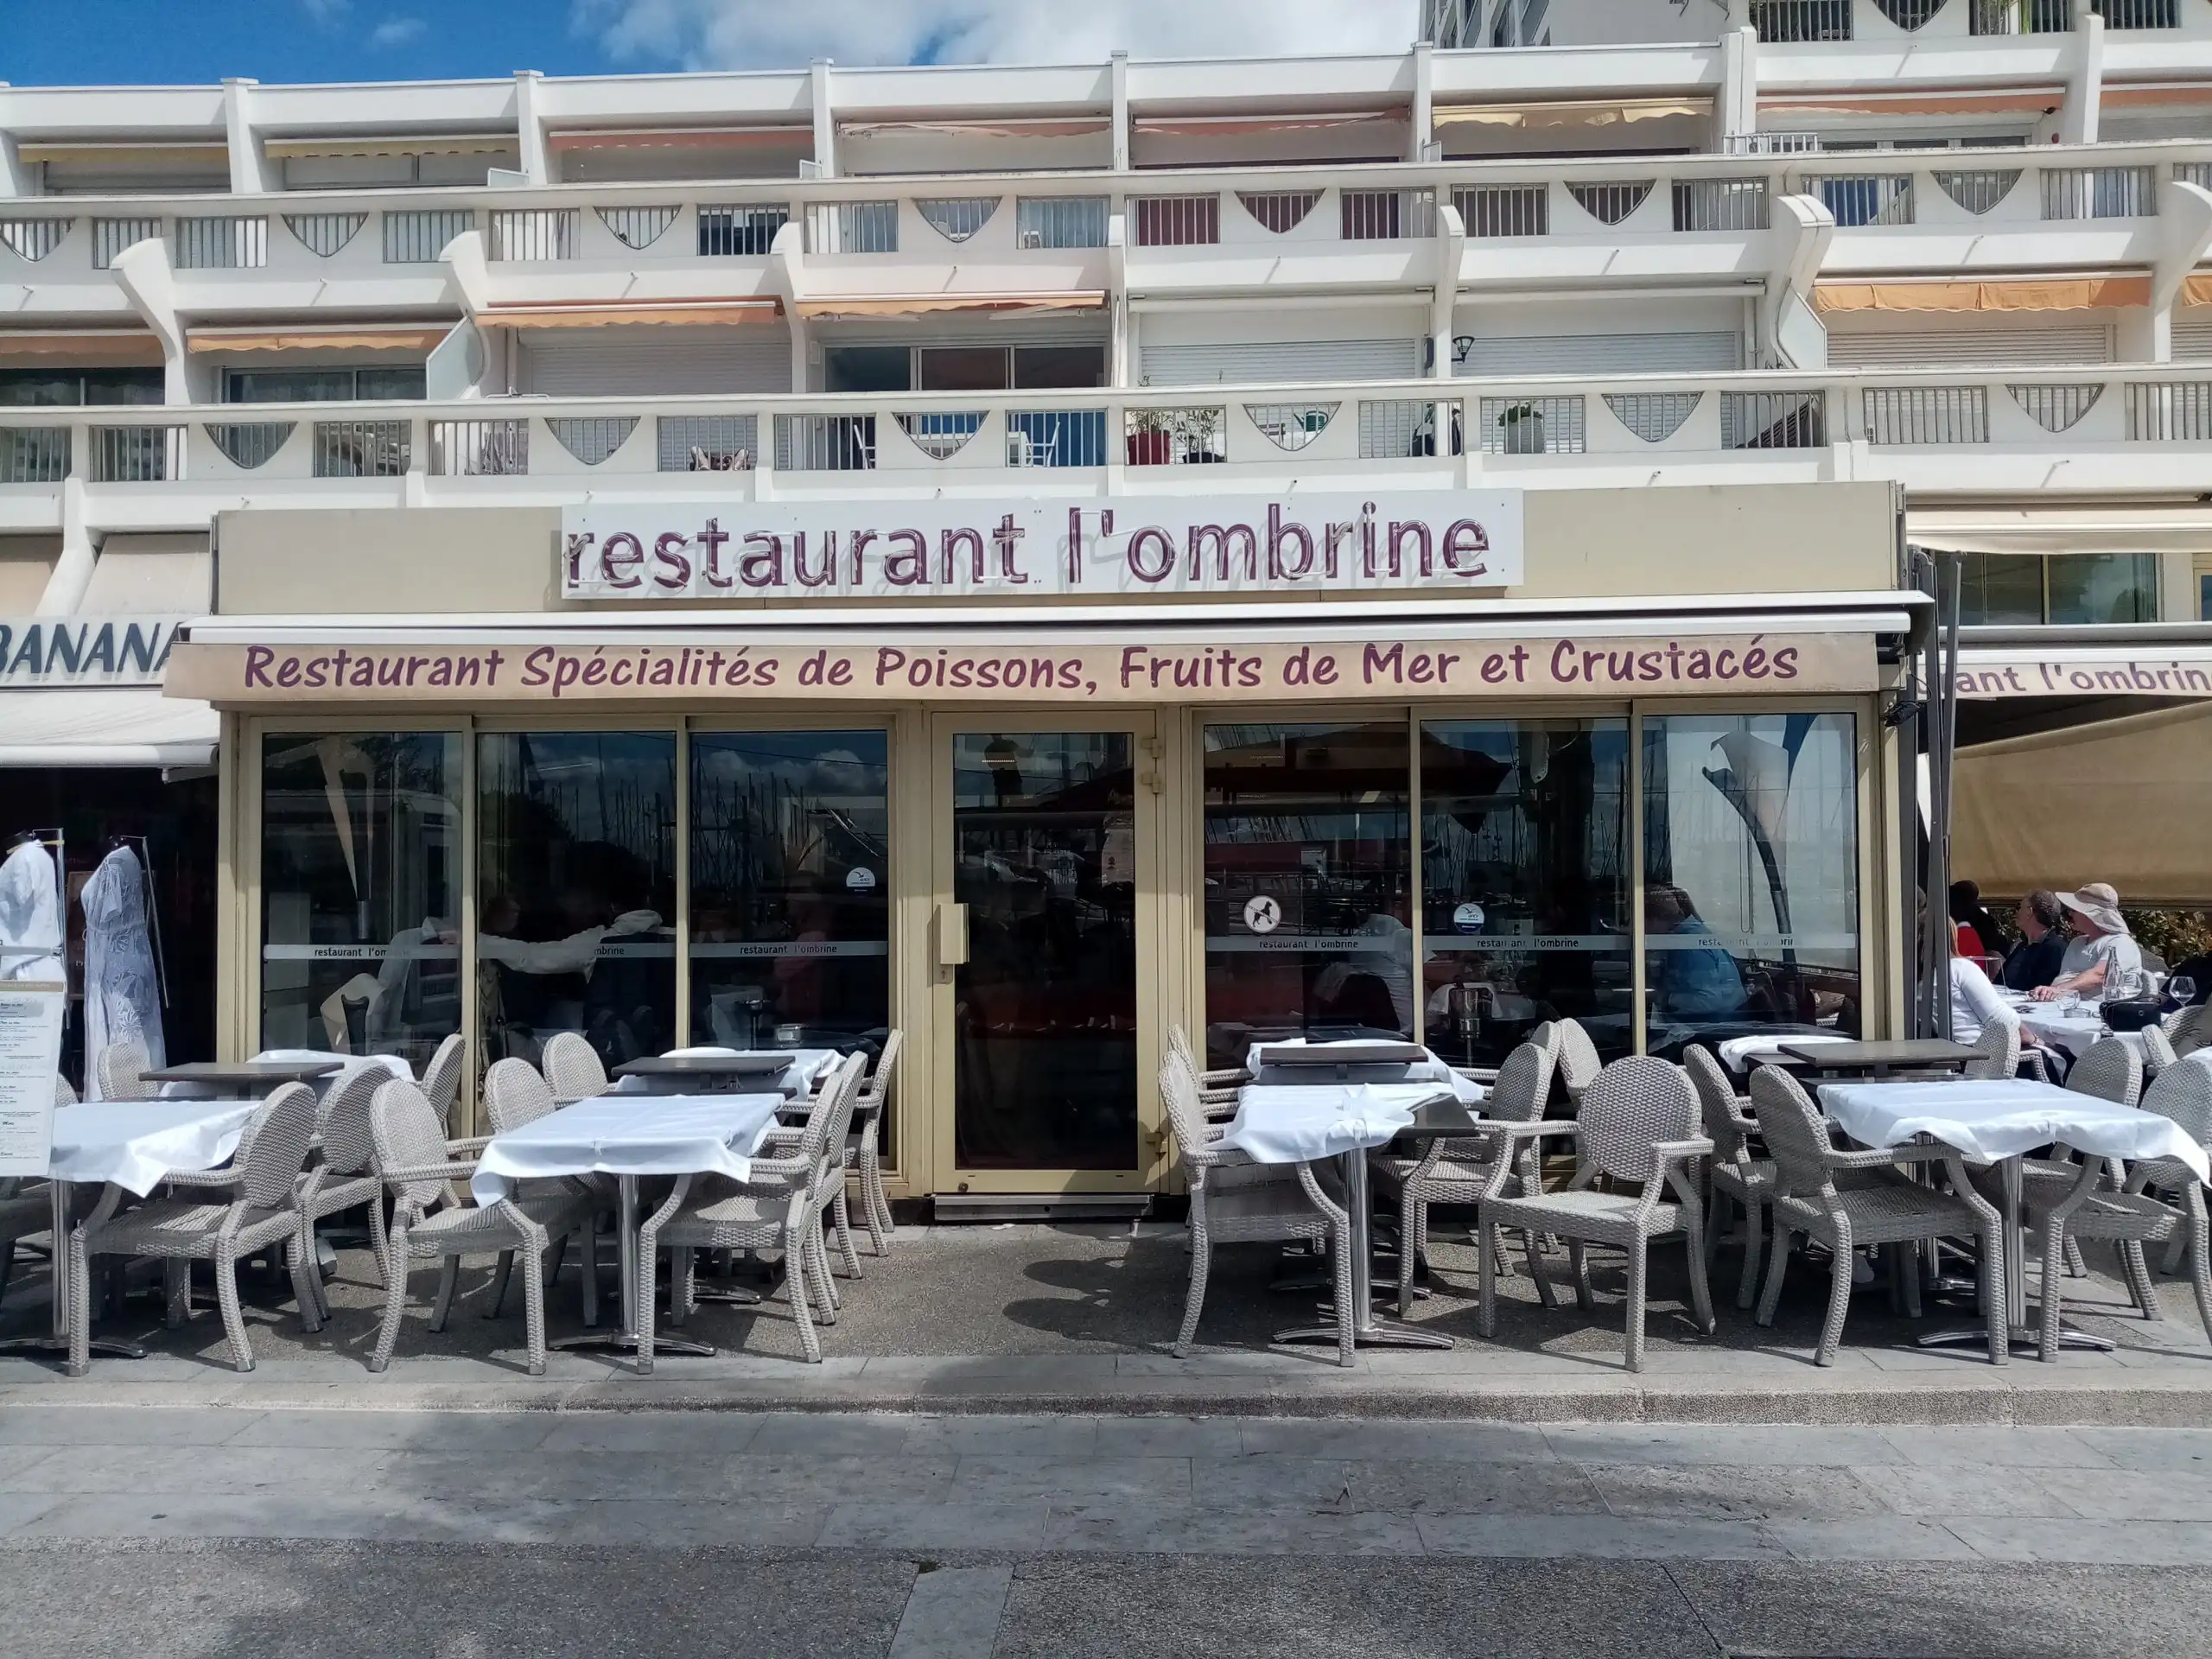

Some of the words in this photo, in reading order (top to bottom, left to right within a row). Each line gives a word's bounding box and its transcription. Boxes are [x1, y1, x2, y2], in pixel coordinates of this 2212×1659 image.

[567, 513, 1029, 588] restaurant
[1068, 501, 1489, 583] l'ombrine
[245, 645, 504, 688] Restaurant
[521, 645, 778, 697] Spécialités
[798, 648, 853, 687] de
[874, 647, 1098, 696] Poissons,
[1120, 645, 1262, 688] Fruits
[1282, 647, 1338, 685] de
[1363, 643, 1462, 684] Mer
[1480, 645, 1529, 683] et
[1550, 634, 1800, 683] Crustacés
[2038, 660, 2212, 692] l'ombrin
[1259, 938, 1308, 949] restaurant
[1314, 938, 1359, 949] l'ombrine
[1534, 938, 1580, 948] l'ombrine
[314, 947, 362, 958] restaurant
[740, 944, 788, 955] restaurant
[795, 944, 838, 954] l'ombrine
